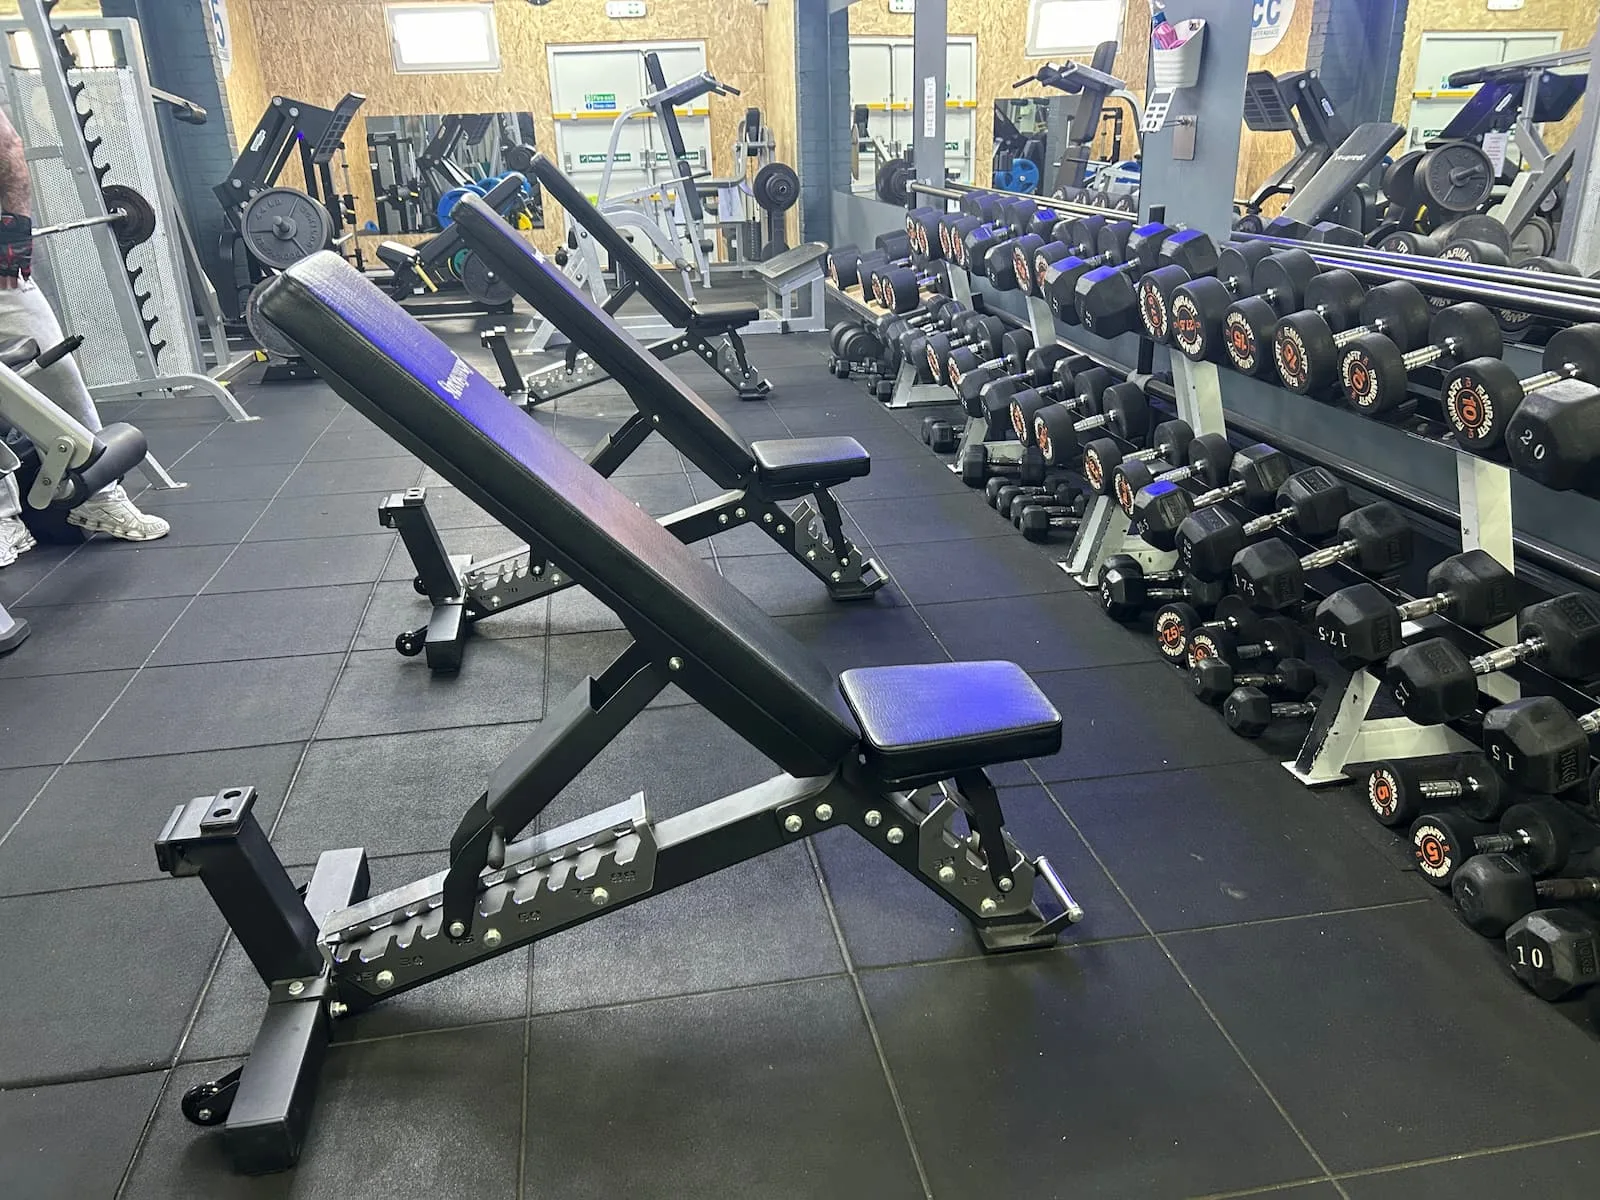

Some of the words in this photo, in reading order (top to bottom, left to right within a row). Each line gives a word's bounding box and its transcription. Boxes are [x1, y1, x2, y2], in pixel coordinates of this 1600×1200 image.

[1462, 396, 1478, 421] 10
[1520, 429, 1546, 460] 20
[1318, 626, 1348, 648] 17.5
[1491, 744, 1515, 771] 15
[1377, 785, 1389, 801] 5
[1426, 841, 1439, 861] 5
[1516, 946, 1544, 968] 10
